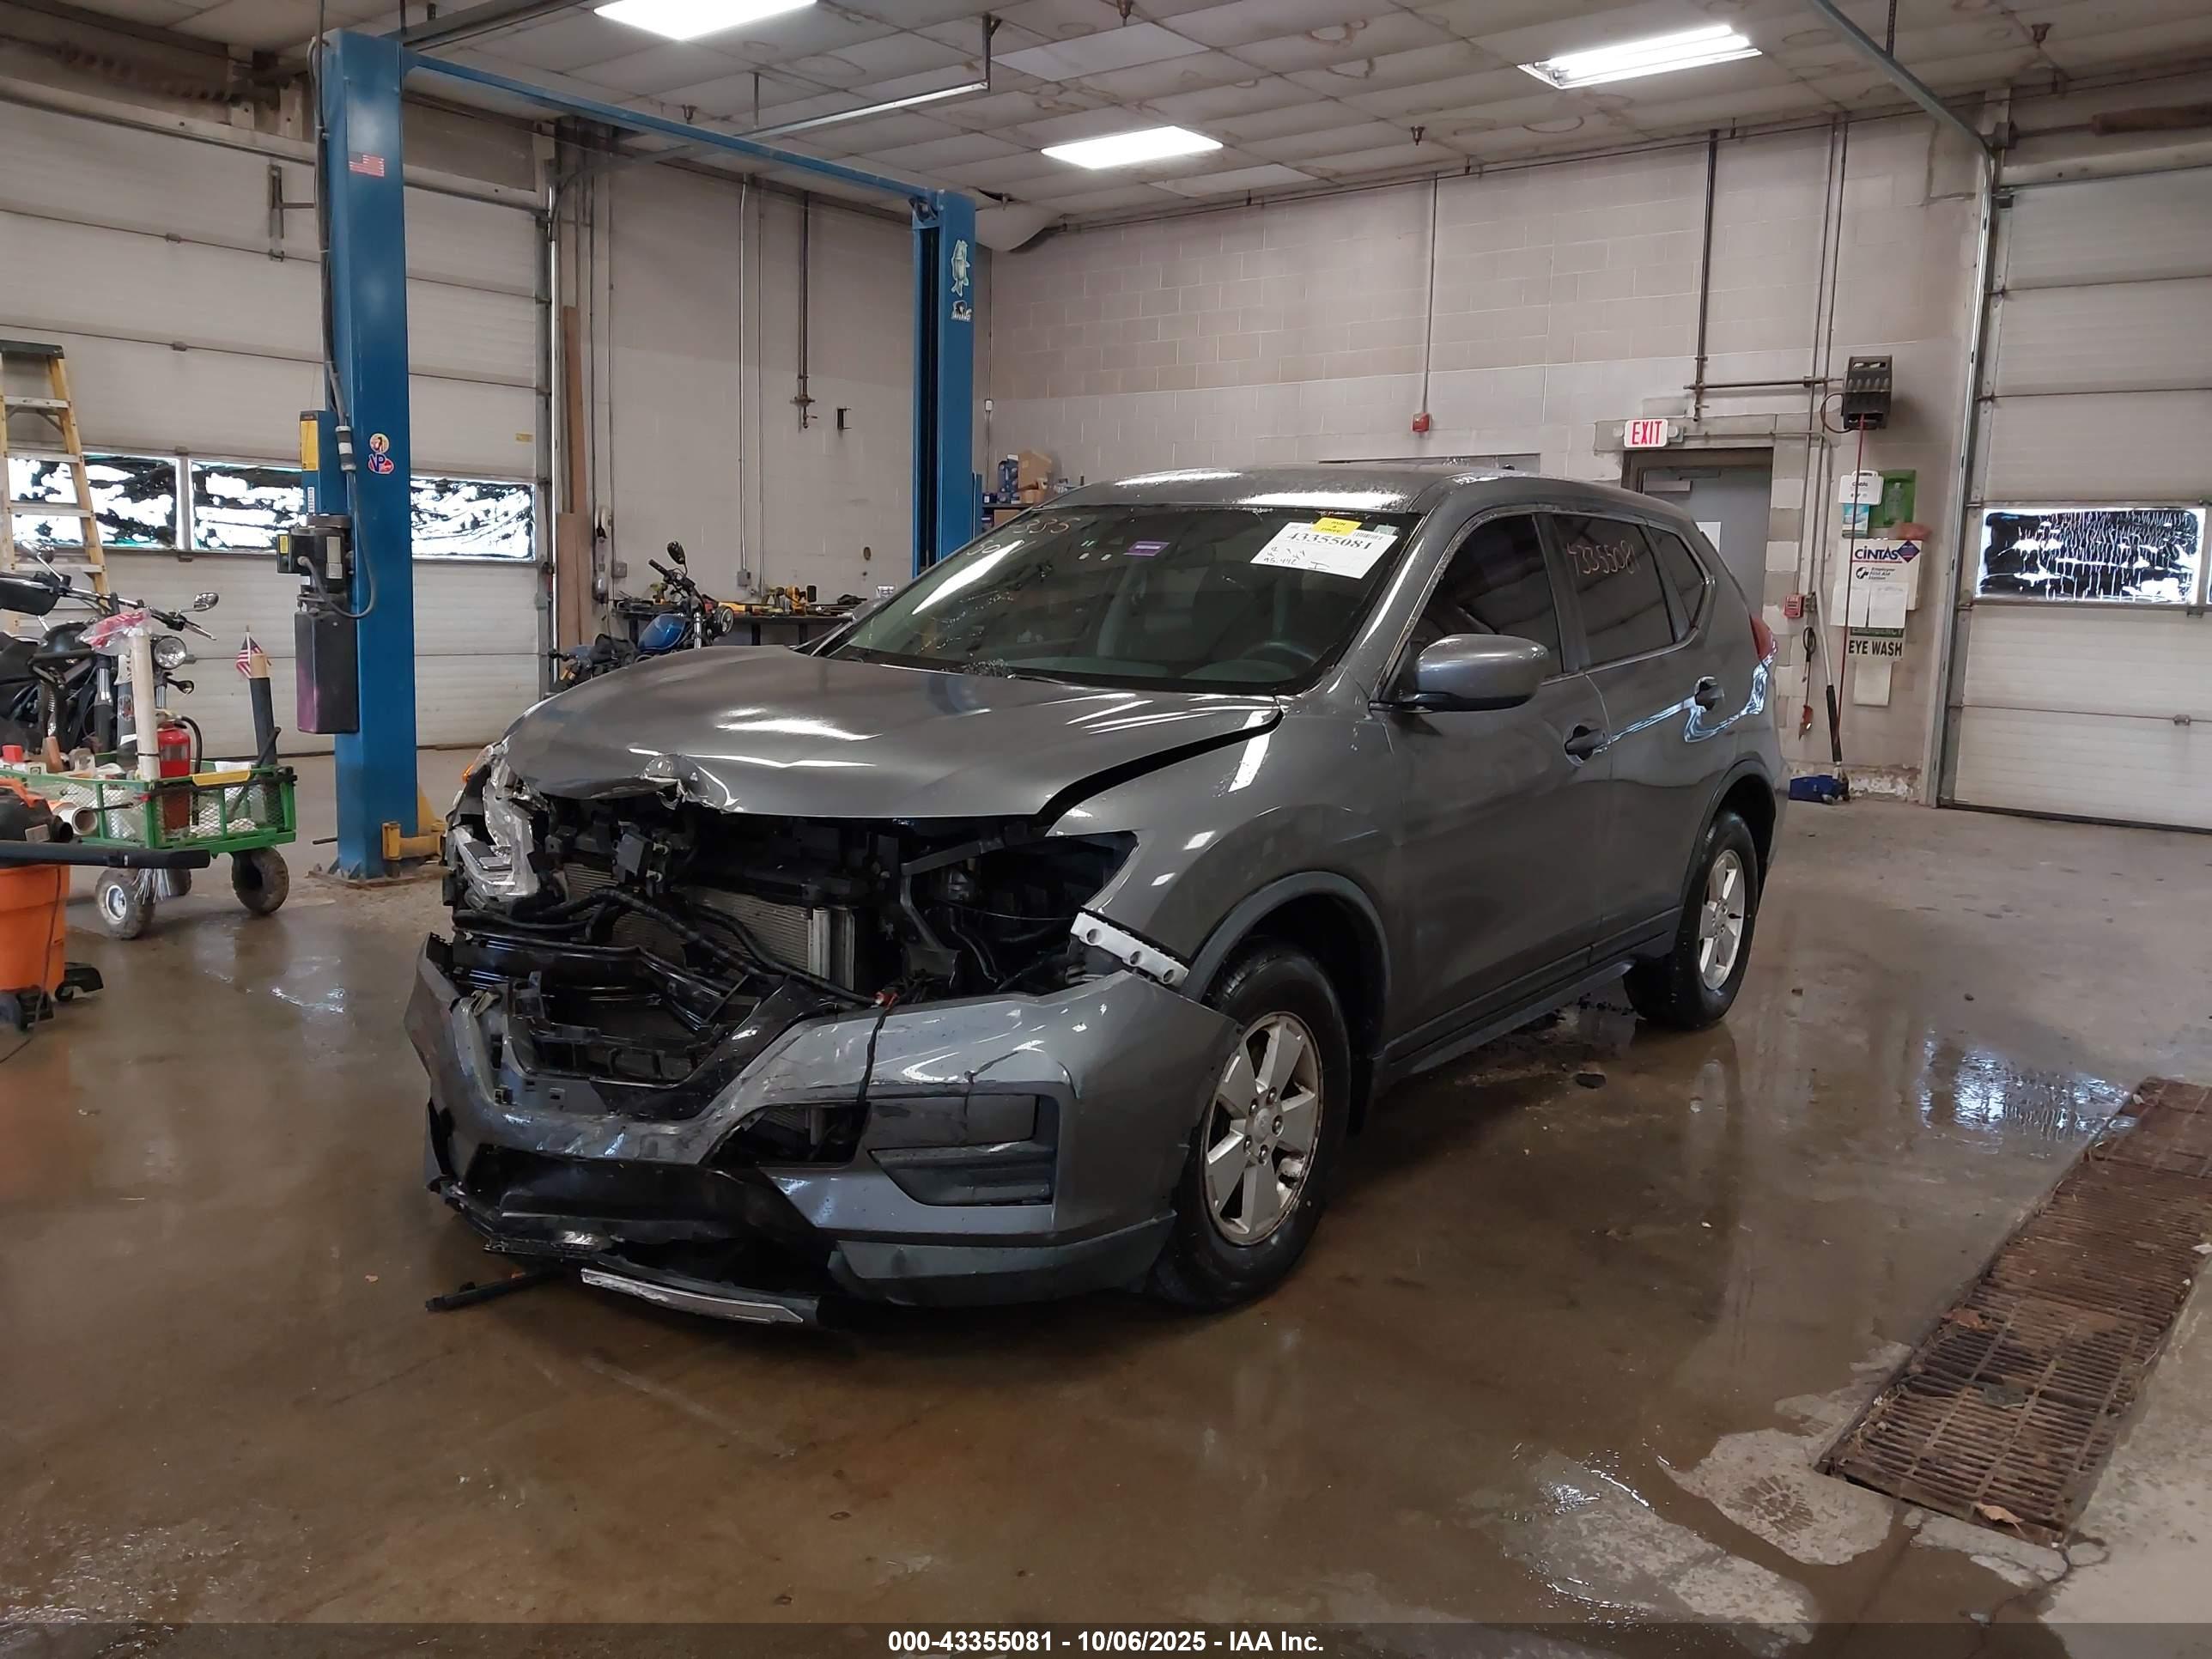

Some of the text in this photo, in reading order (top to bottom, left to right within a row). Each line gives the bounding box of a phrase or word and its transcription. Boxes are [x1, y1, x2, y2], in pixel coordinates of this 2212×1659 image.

[1632, 421, 1662, 445] EXIT
[1286, 532, 1372, 550] 43355081
[1854, 545, 1899, 560] CINTAS
[1849, 640, 1903, 657] EYE WASH
